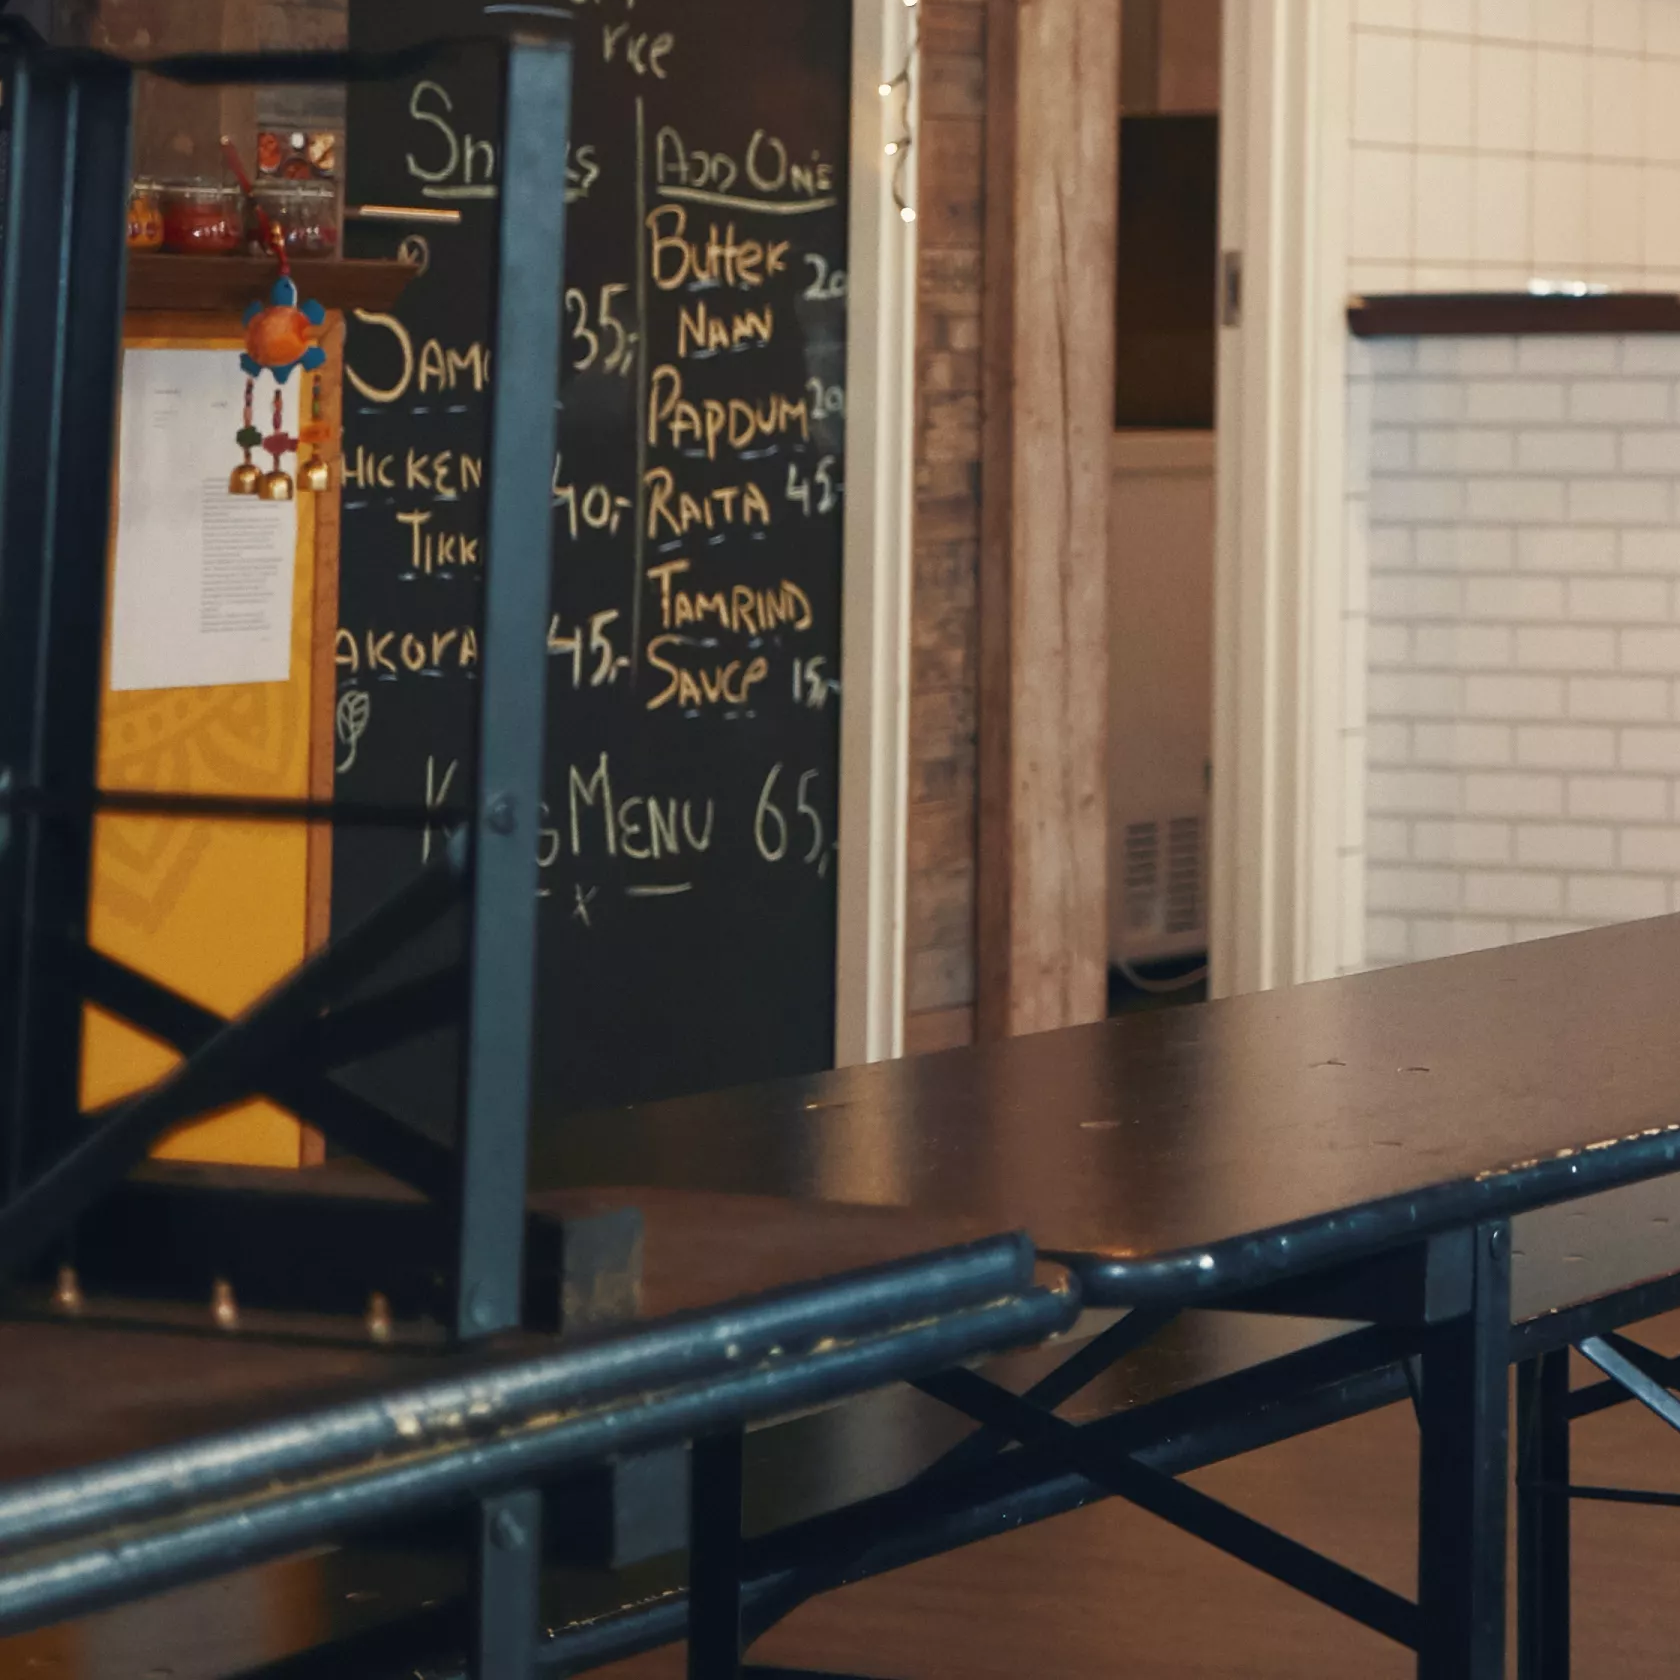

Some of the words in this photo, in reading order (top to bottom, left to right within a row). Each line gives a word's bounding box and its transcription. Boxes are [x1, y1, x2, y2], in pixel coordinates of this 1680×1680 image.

[340, 446, 482, 498] HICKEN
[644, 467, 771, 539] RAITA
[396, 510, 480, 574] TIKK
[569, 751, 715, 861] MENU
